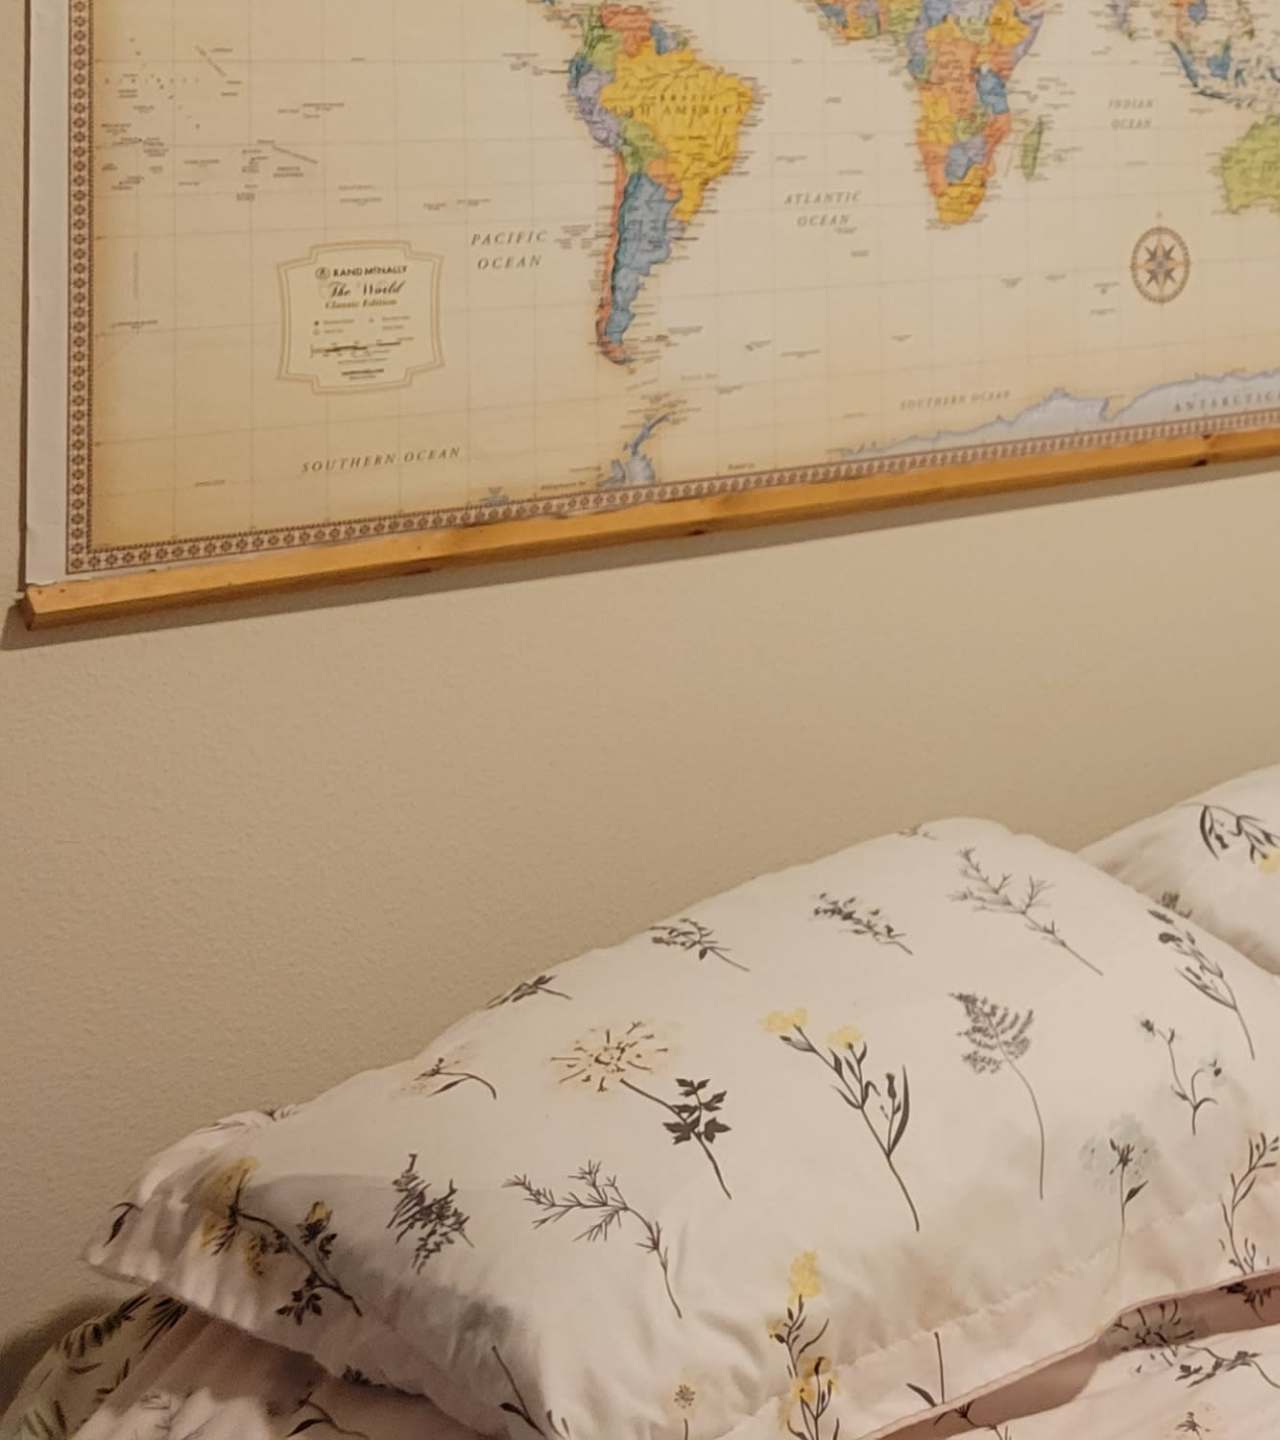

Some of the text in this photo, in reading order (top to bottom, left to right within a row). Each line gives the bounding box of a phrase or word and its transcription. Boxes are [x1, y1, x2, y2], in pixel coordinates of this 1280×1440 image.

[784, 190, 861, 206] ATLANTIC
[797, 213, 850, 227] OCEAN
[471, 230, 548, 247] PACIFIC
[477, 254, 543, 270] OCEAN
[333, 266, 362, 277] RAND
[360, 280, 407, 296] World
[302, 446, 461, 474] SOUTHERN OCEAN
